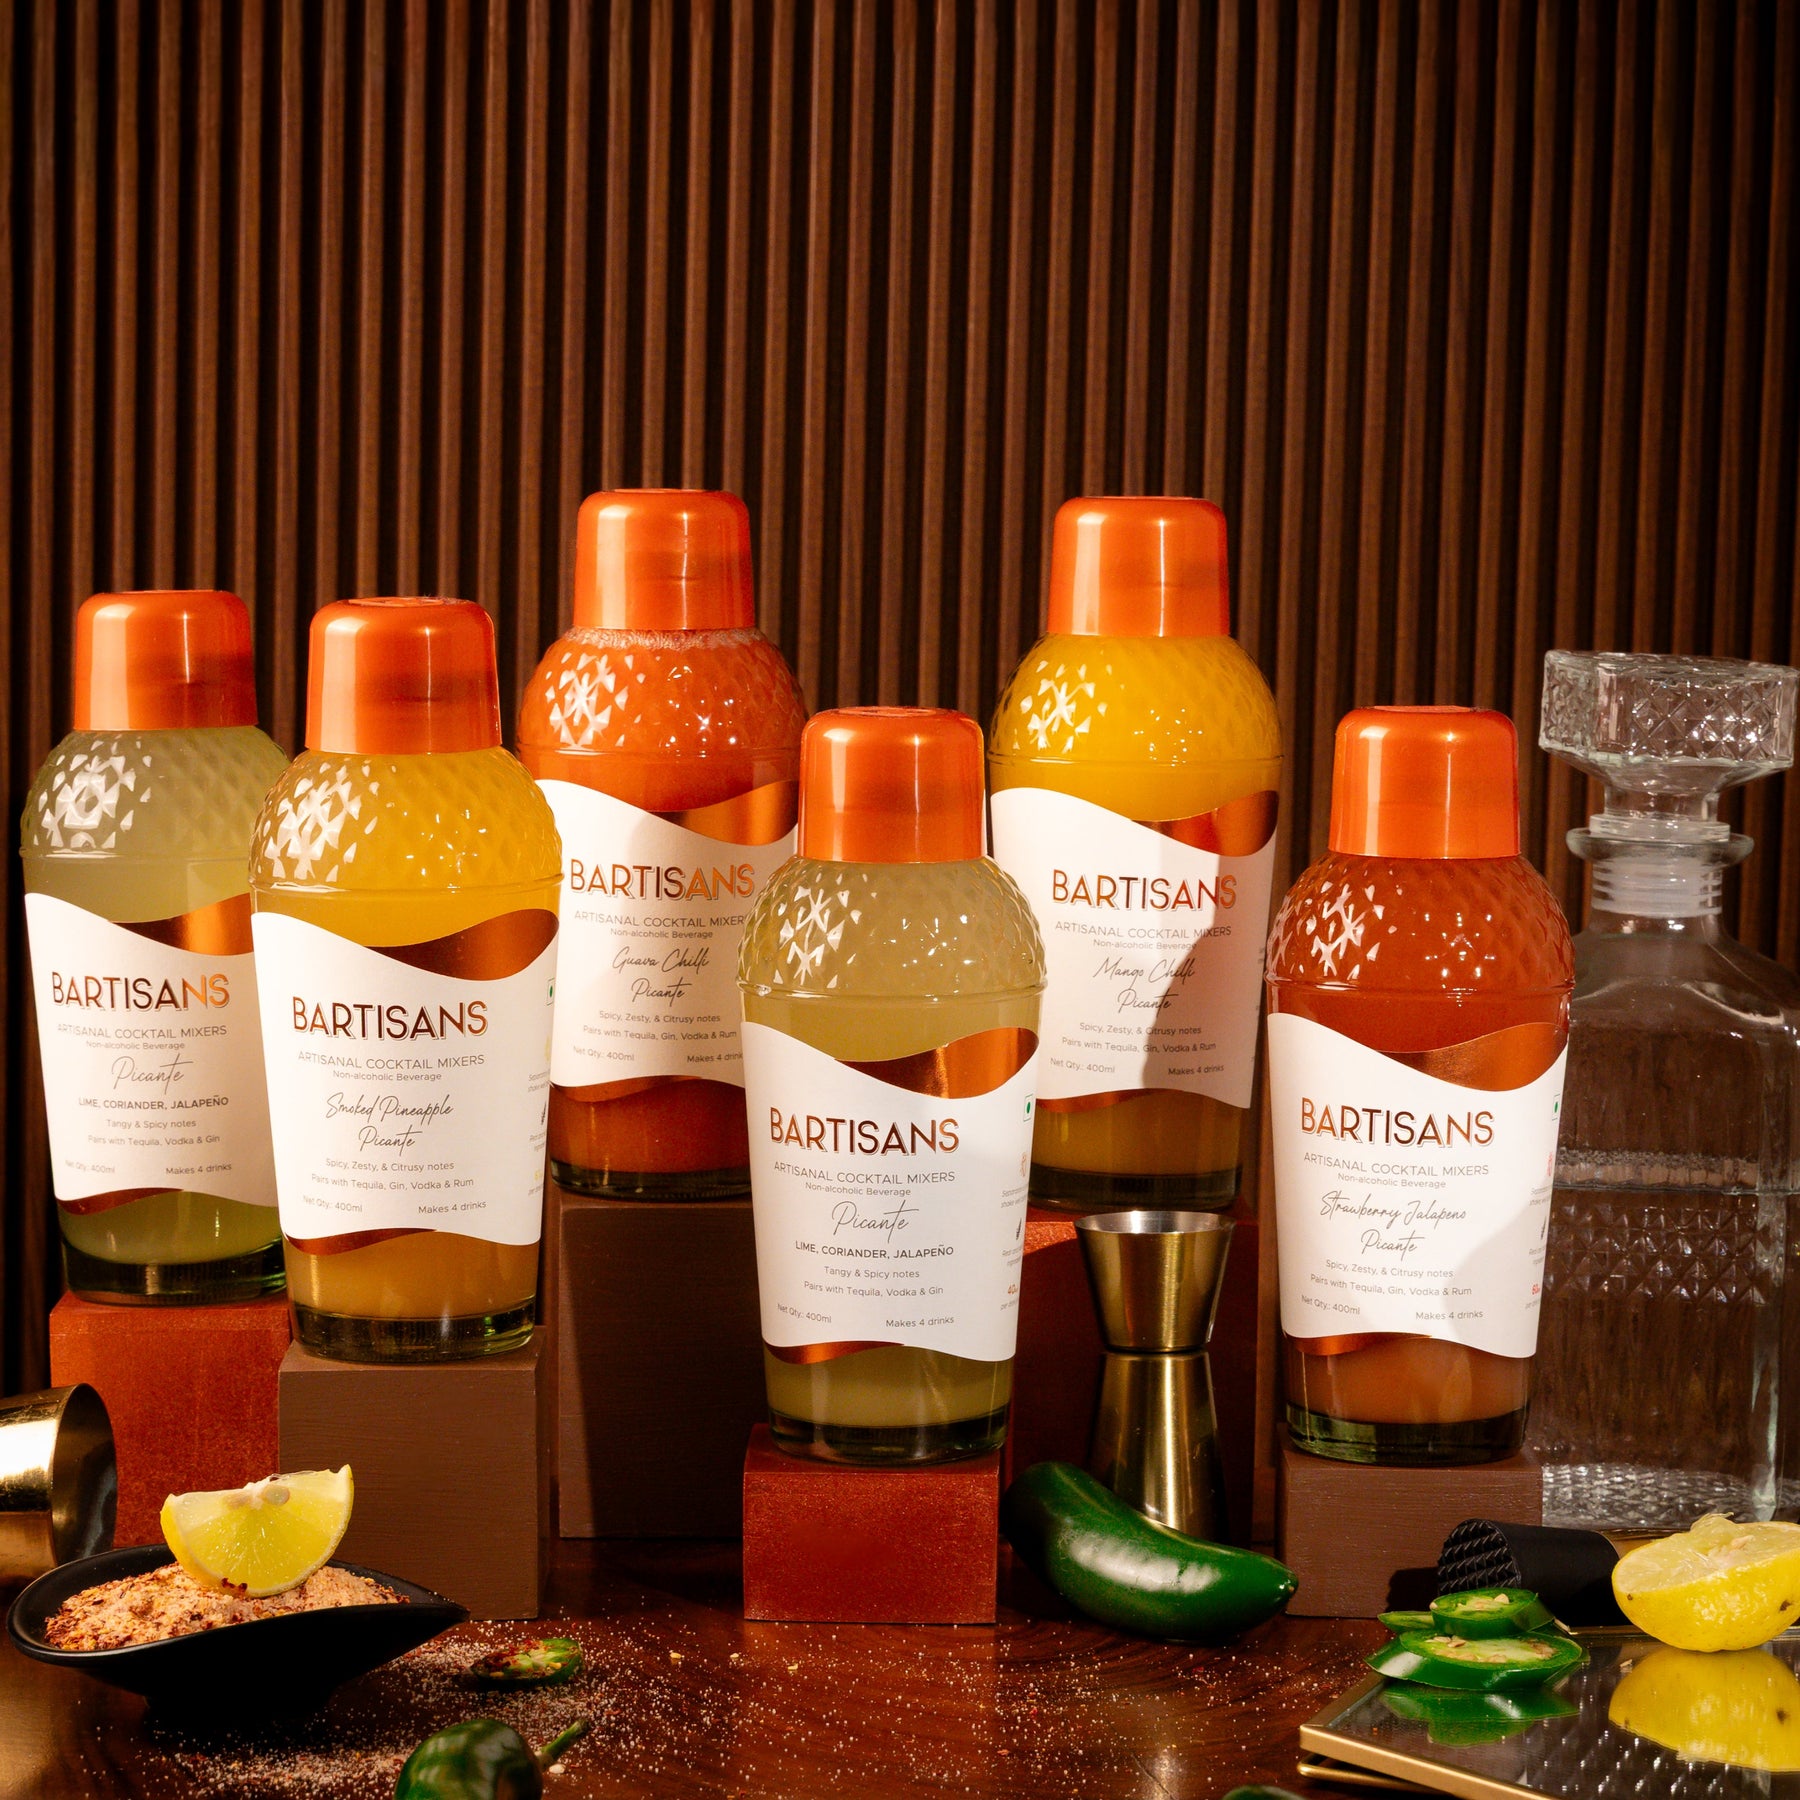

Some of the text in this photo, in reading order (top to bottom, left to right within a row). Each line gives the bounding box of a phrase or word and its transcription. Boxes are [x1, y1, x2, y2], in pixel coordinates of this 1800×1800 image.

[571, 859, 755, 900] BARTISANS
[1053, 869, 1236, 911] BARTISANS
[574, 910, 748, 927] ARTISANAL COCKTAIL MIXER
[611, 928, 713, 939] Non-alcoholic Beverage
[1055, 921, 1231, 938] ARTISANAL COCKTAIL MIXERS
[1094, 939, 1196, 950] Non-alcoholic Beverage
[613, 946, 709, 974] Guava Chilli
[1093, 957, 1195, 989] Mango Chilli
[52, 972, 229, 1012] BARTISANS
[631, 977, 692, 1007] Picante
[1117, 988, 1179, 1018] Picante
[293, 996, 488, 1041] BARTISANS
[600, 1011, 622, 1021] Spicy,
[625, 1013, 651, 1023] Zesty,
[664, 1015, 693, 1024] Citrusy
[58, 1024, 227, 1039] ARTISANAL COCKTAIL MIXERS
[583, 1025, 601, 1035] Pairs
[604, 1027, 621, 1037] with
[624, 1031, 658, 1040] Tequila,
[661, 1032, 678, 1040] Gin,
[681, 1032, 708, 1040] Vodka
[1080, 1023, 1103, 1033] Spicy,
[1107, 1025, 1133, 1035] Zesty,
[1146, 1027, 1175, 1036] Citrusy
[1179, 1026, 1201, 1034] notes
[86, 1040, 185, 1050] Non-alcoholic Beverage
[1062, 1037, 1081, 1047] Pairs
[1085, 1040, 1102, 1049] with
[1105, 1042, 1140, 1052] Tequila,
[1143, 1044, 1160, 1053] Gin,
[1200, 1042, 1216, 1051] Rum
[298, 1051, 485, 1070] ARTISANAL COCKTAIL MIXERS
[1050, 1057, 1064, 1066] Net
[1086, 1064, 1115, 1073] 400ml
[1204, 1065, 1224, 1073] drinks
[112, 1053, 194, 1095] Picante
[333, 1070, 442, 1082] Non-alcoholic Beverage
[104, 1100, 168, 1110] CORIANDER,
[171, 1095, 228, 1109] JALAPEÑO
[326, 1092, 453, 1125] Smoked Pineapple
[108, 1120, 132, 1129] Tangy
[144, 1120, 167, 1129] Spicy
[1302, 1097, 1494, 1147] BARTISANS
[770, 1107, 959, 1156] BARTISANS
[89, 1135, 106, 1144] Pairs
[109, 1136, 125, 1145] with
[128, 1138, 162, 1146] Tequila,
[165, 1136, 193, 1145] Vodka
[206, 1135, 220, 1143] Gin
[359, 1125, 423, 1156] Picante
[166, 1167, 194, 1175] Makes
[206, 1163, 231, 1172] drinks
[326, 1158, 454, 1173] Spicy, Zesty, & Citrusy notes
[774, 1161, 955, 1184] ARTISANAL COCKTAIL MIXERS
[1304, 1152, 1489, 1176] ARTISANAL COCKTAIL MIXERS
[311, 1174, 474, 1191] Pairs with Tequila, Gin, Vodka & Rum
[805, 1182, 911, 1196] Non-alcoholic Beverage
[1338, 1173, 1446, 1189] Non-alcoholic Beverage
[419, 1205, 448, 1213] Makes
[461, 1201, 486, 1211] drinks
[1320, 1190, 1401, 1229] Strawberry
[832, 1200, 919, 1243] Picante
[796, 1241, 954, 1259] LIME, CORIANDER, JALAPEÑO
[1361, 1229, 1425, 1261] Picante
[824, 1266, 919, 1279] Tangy & Spicy notes
[1326, 1259, 1349, 1271] Spicy,
[1352, 1264, 1378, 1275] Zesty,
[1391, 1268, 1424, 1278] Citrusy
[1427, 1269, 1453, 1278] notes
[804, 1281, 822, 1291] Pairs
[826, 1285, 843, 1294] with
[847, 1287, 883, 1297] Tequila,
[886, 1288, 916, 1296] Vodka
[929, 1287, 943, 1295] Gin
[1311, 1274, 1472, 1296] Pairs with Tequila, Gin, Vodka & Rum
[778, 1303, 788, 1312] Net
[806, 1312, 831, 1323] 400ml
[1302, 1295, 1312, 1305] Net
[1333, 1303, 1360, 1315] 400ml
[886, 1319, 916, 1327] Makes
[928, 1316, 954, 1325] drinks
[1416, 1312, 1445, 1320] Makes
[1457, 1310, 1483, 1319] drinks
